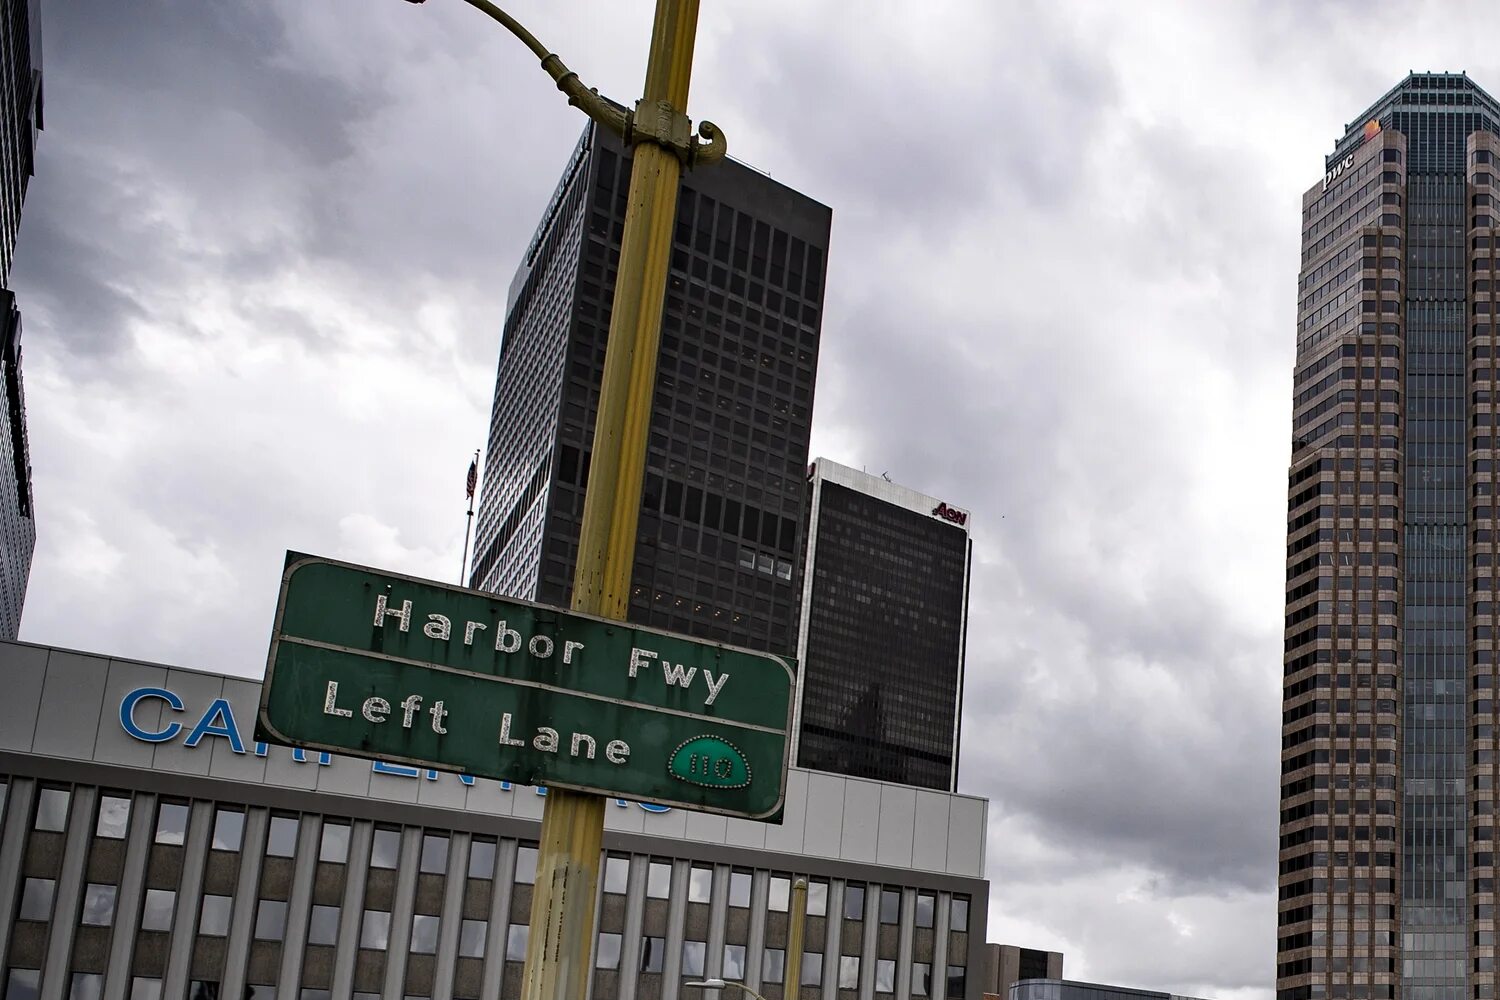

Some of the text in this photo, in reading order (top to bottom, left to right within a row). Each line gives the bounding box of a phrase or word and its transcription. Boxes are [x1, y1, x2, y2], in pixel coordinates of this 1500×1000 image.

[1322, 153, 1354, 192] pwc
[931, 501, 967, 526] AON
[374, 594, 730, 707] Harbor Fwy
[323, 680, 450, 734] Left
[498, 713, 632, 764] Lane
[690, 752, 732, 779] 110
